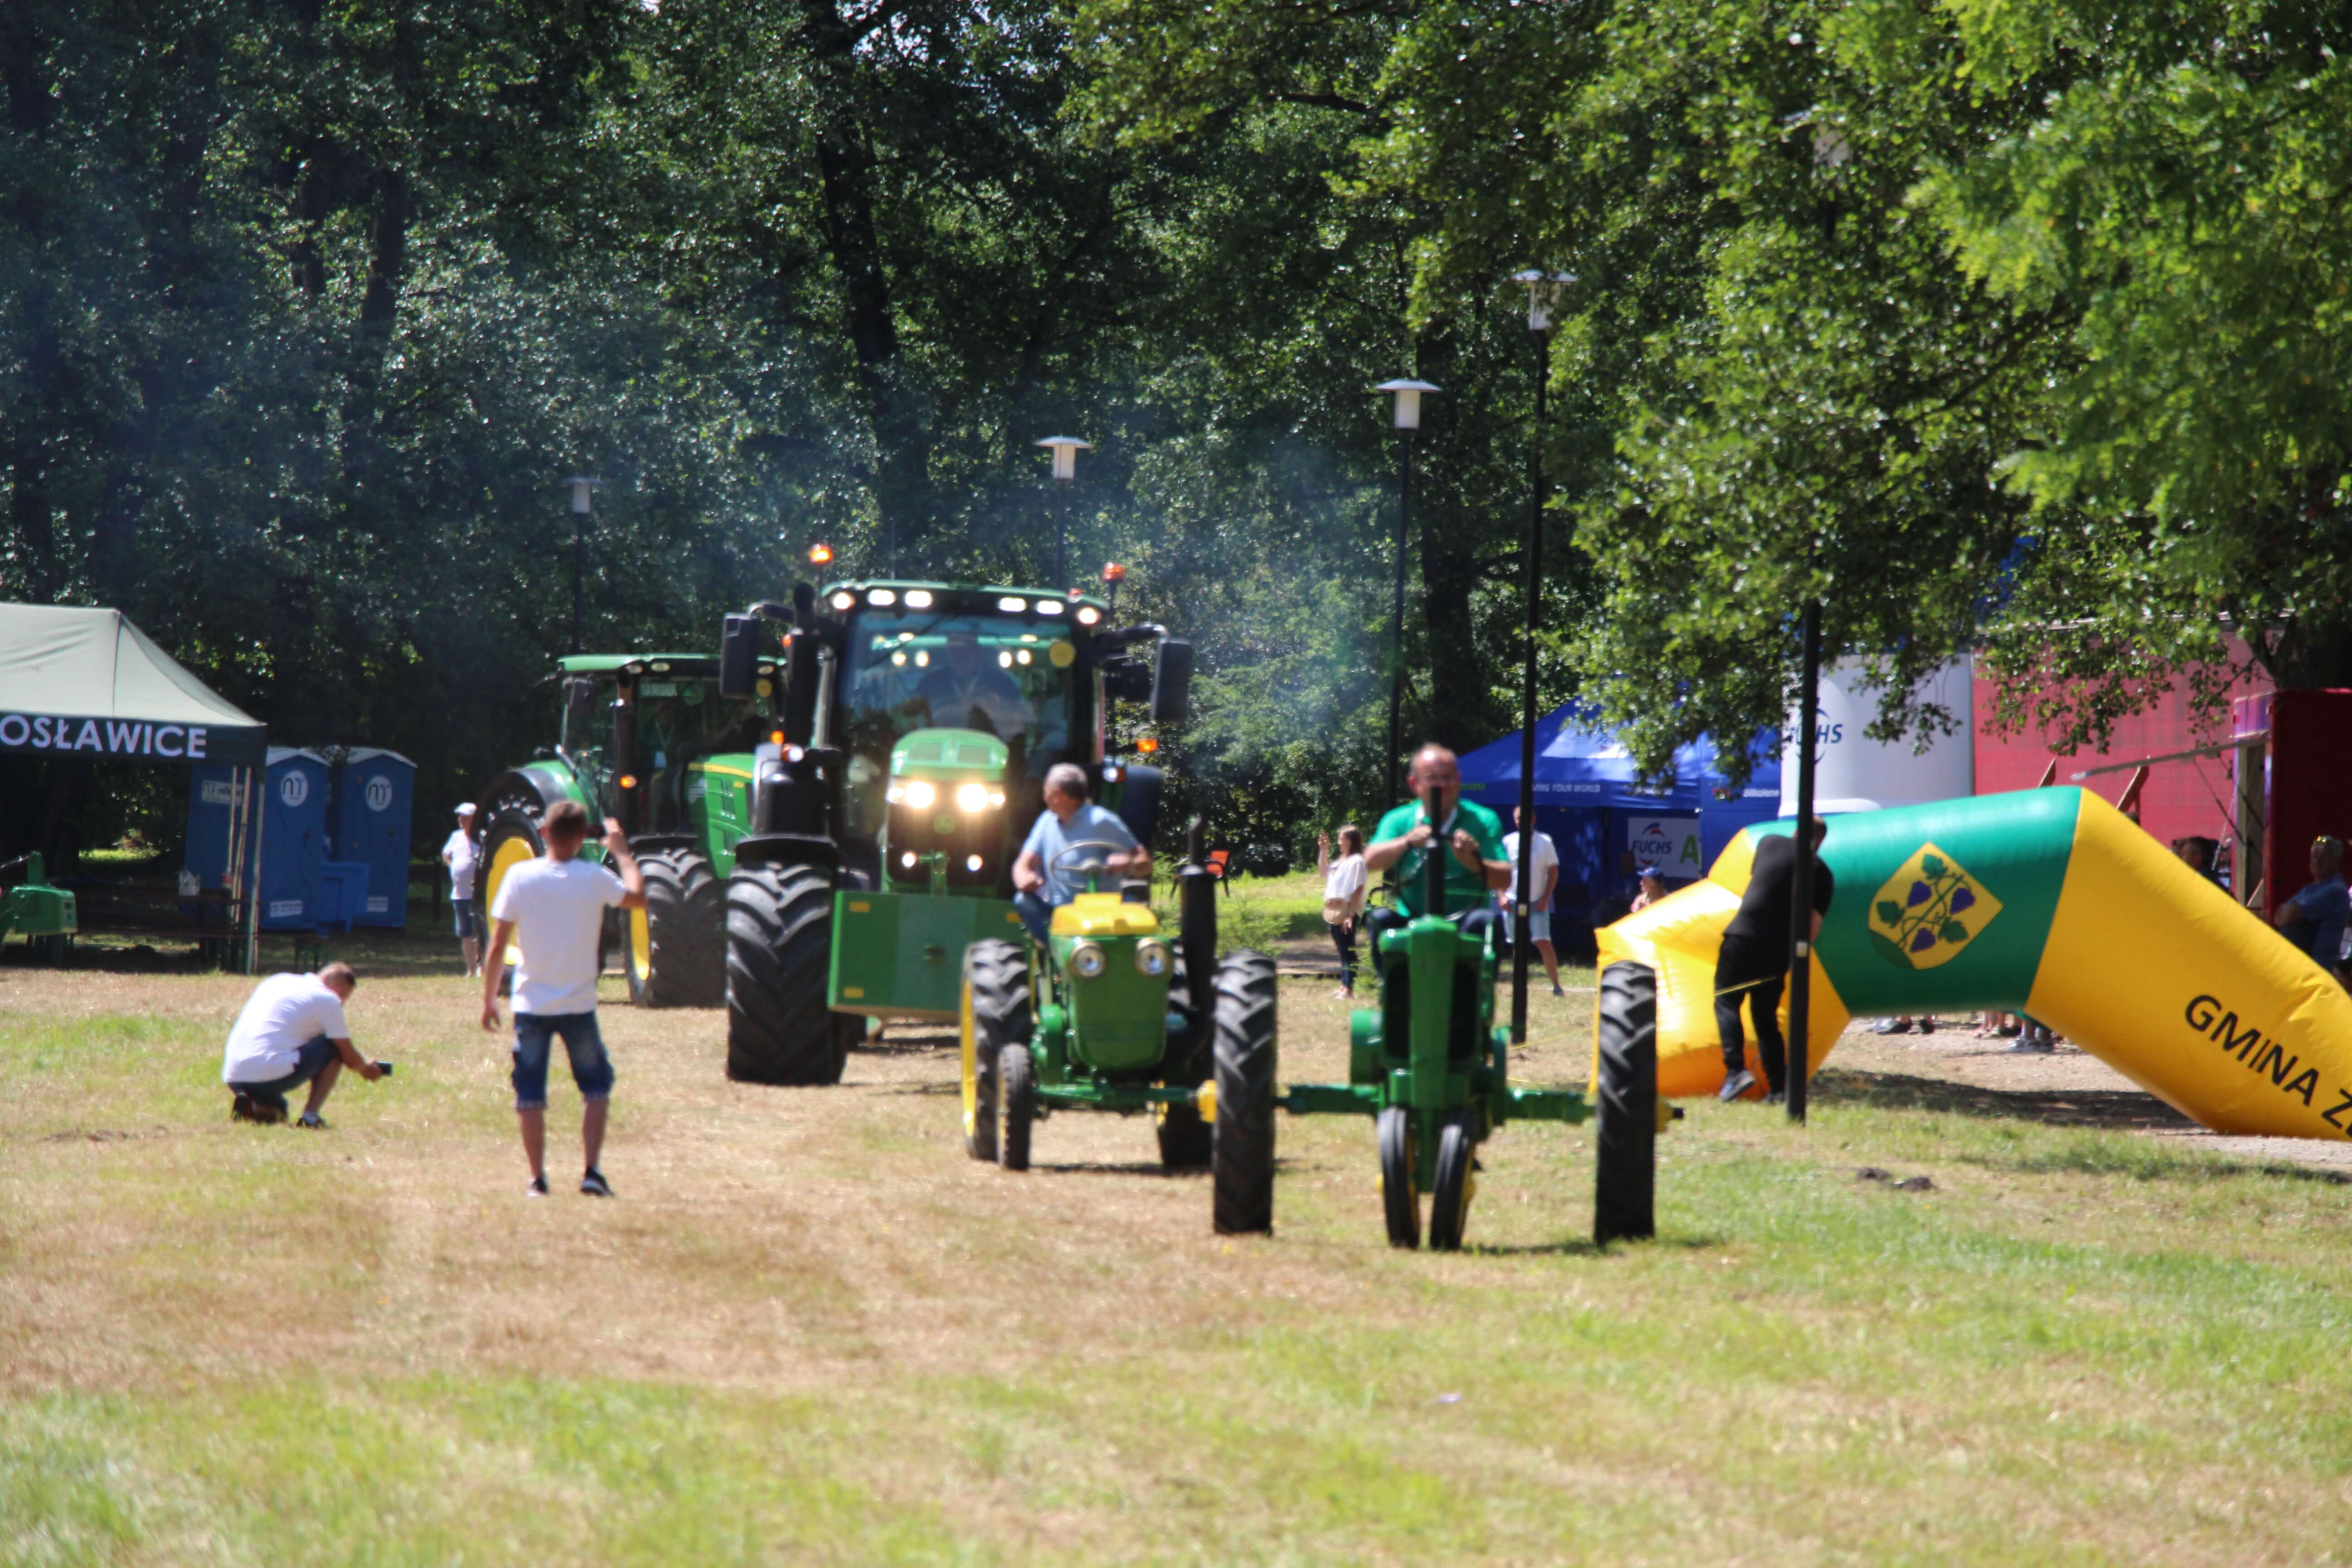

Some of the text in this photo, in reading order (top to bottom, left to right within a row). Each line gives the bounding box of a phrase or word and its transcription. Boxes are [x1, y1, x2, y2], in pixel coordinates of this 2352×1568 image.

[0, 715, 207, 758] OSŁAWICE
[1553, 784, 1572, 792] YOUR
[1574, 784, 1600, 793] WORLD
[1632, 840, 1673, 854] FUCHS
[2185, 995, 2319, 1107] GMINA
